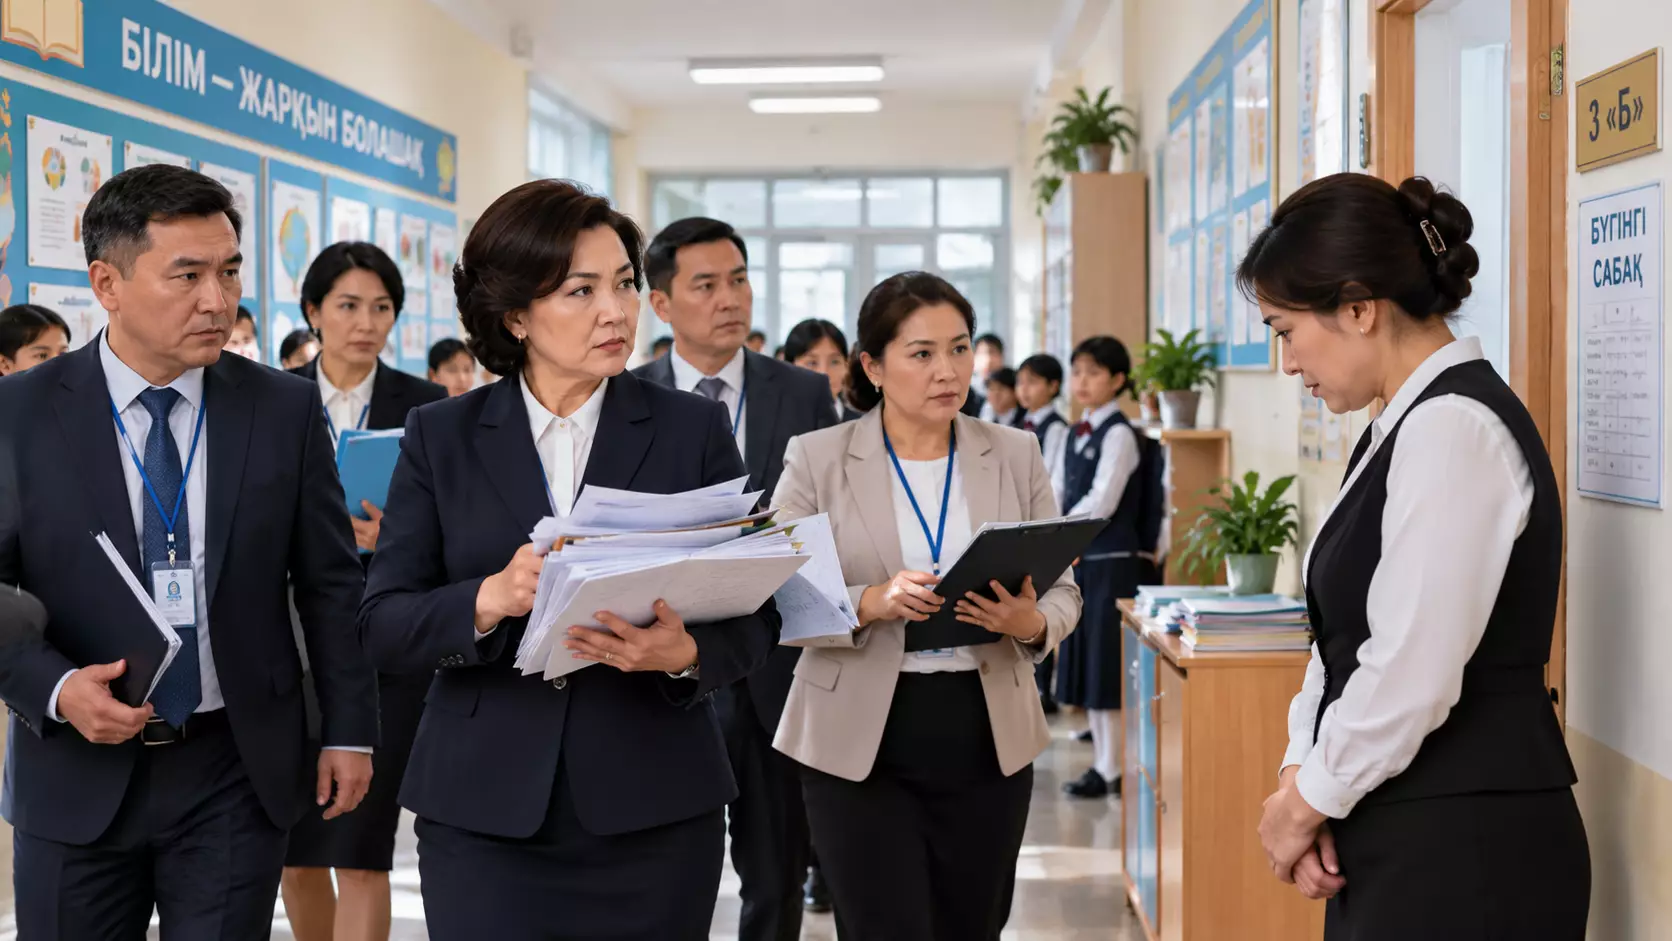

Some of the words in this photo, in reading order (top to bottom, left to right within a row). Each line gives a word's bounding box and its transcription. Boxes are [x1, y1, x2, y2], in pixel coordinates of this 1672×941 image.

[122, 17, 206, 96] БІЛІМ
[238, 65, 337, 144] ЖАРҚЫН
[341, 109, 425, 179] БОЛАШАҚ
[1589, 98, 1600, 142] 3
[1606, 86, 1644, 132] «Б»
[1591, 206, 1646, 245] БҮГІНГІ
[1593, 252, 1643, 289] САБАҚ
